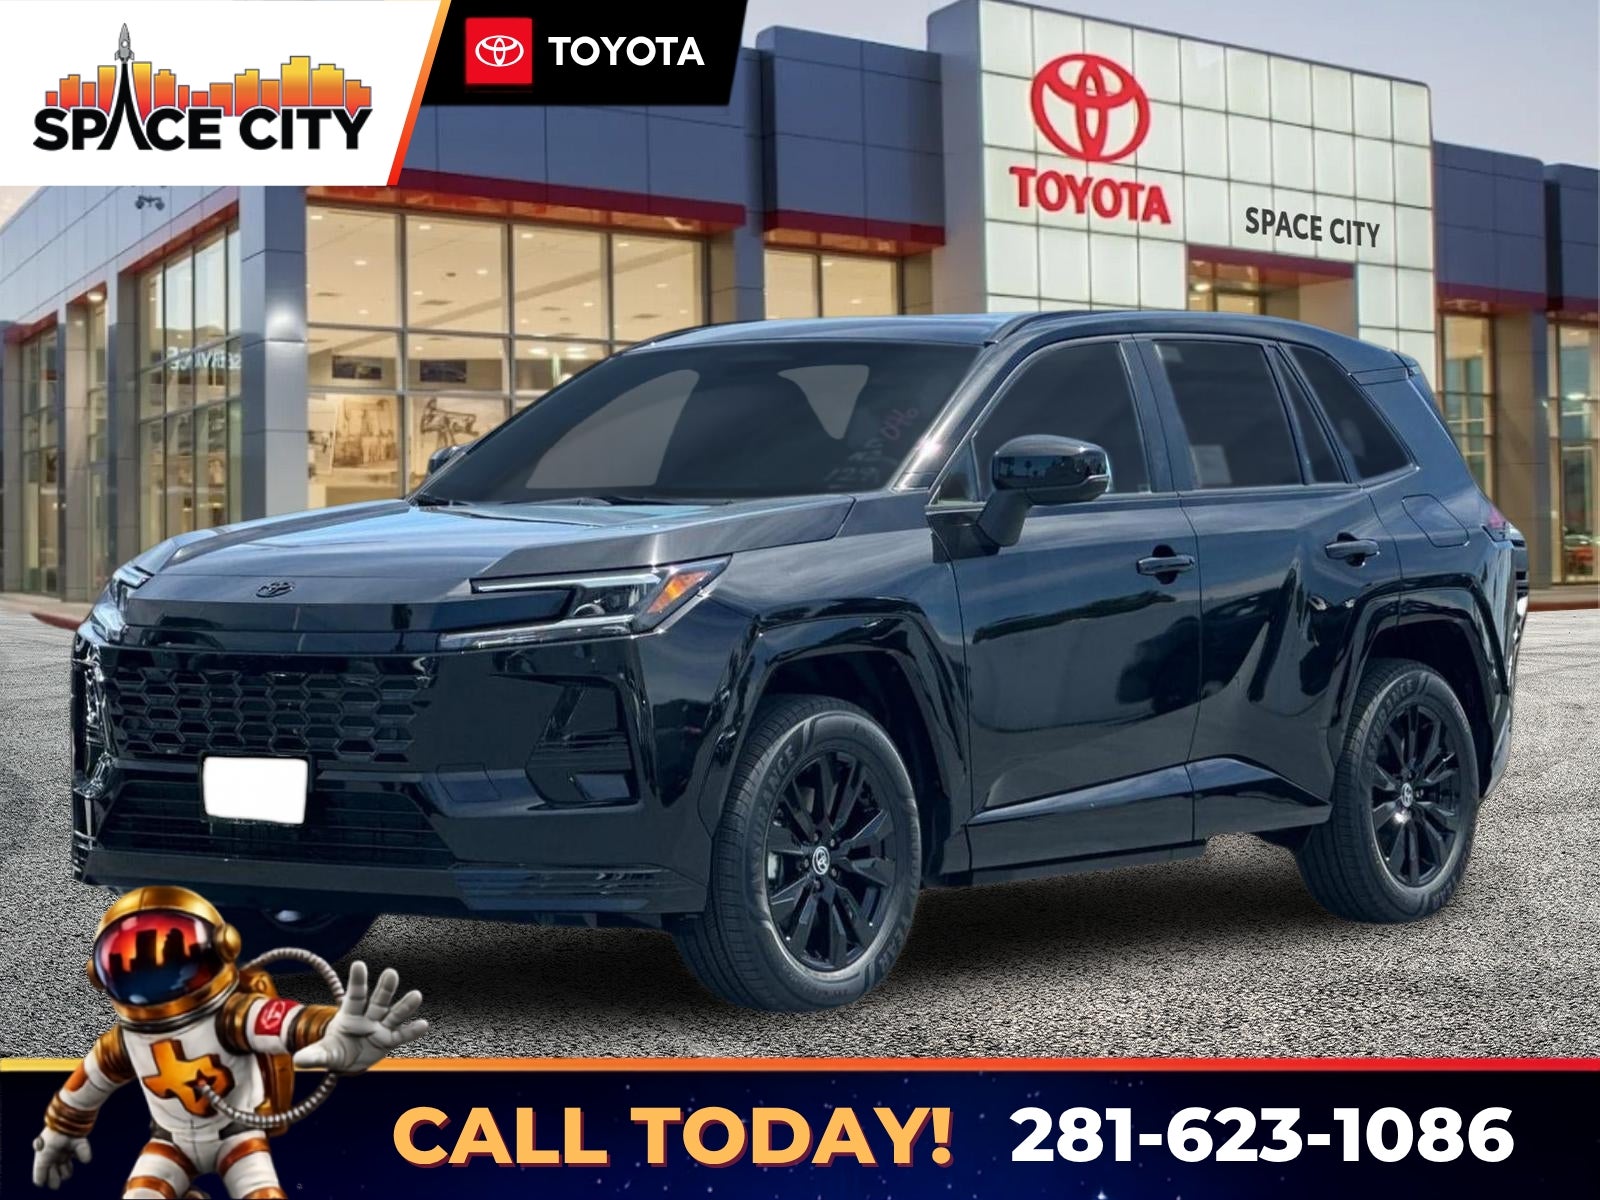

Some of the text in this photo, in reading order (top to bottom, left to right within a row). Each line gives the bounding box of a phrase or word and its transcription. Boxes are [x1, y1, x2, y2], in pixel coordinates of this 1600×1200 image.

[1009, 166, 1171, 225] TOYOTA
[1245, 206, 1381, 248] SPACE CITY
